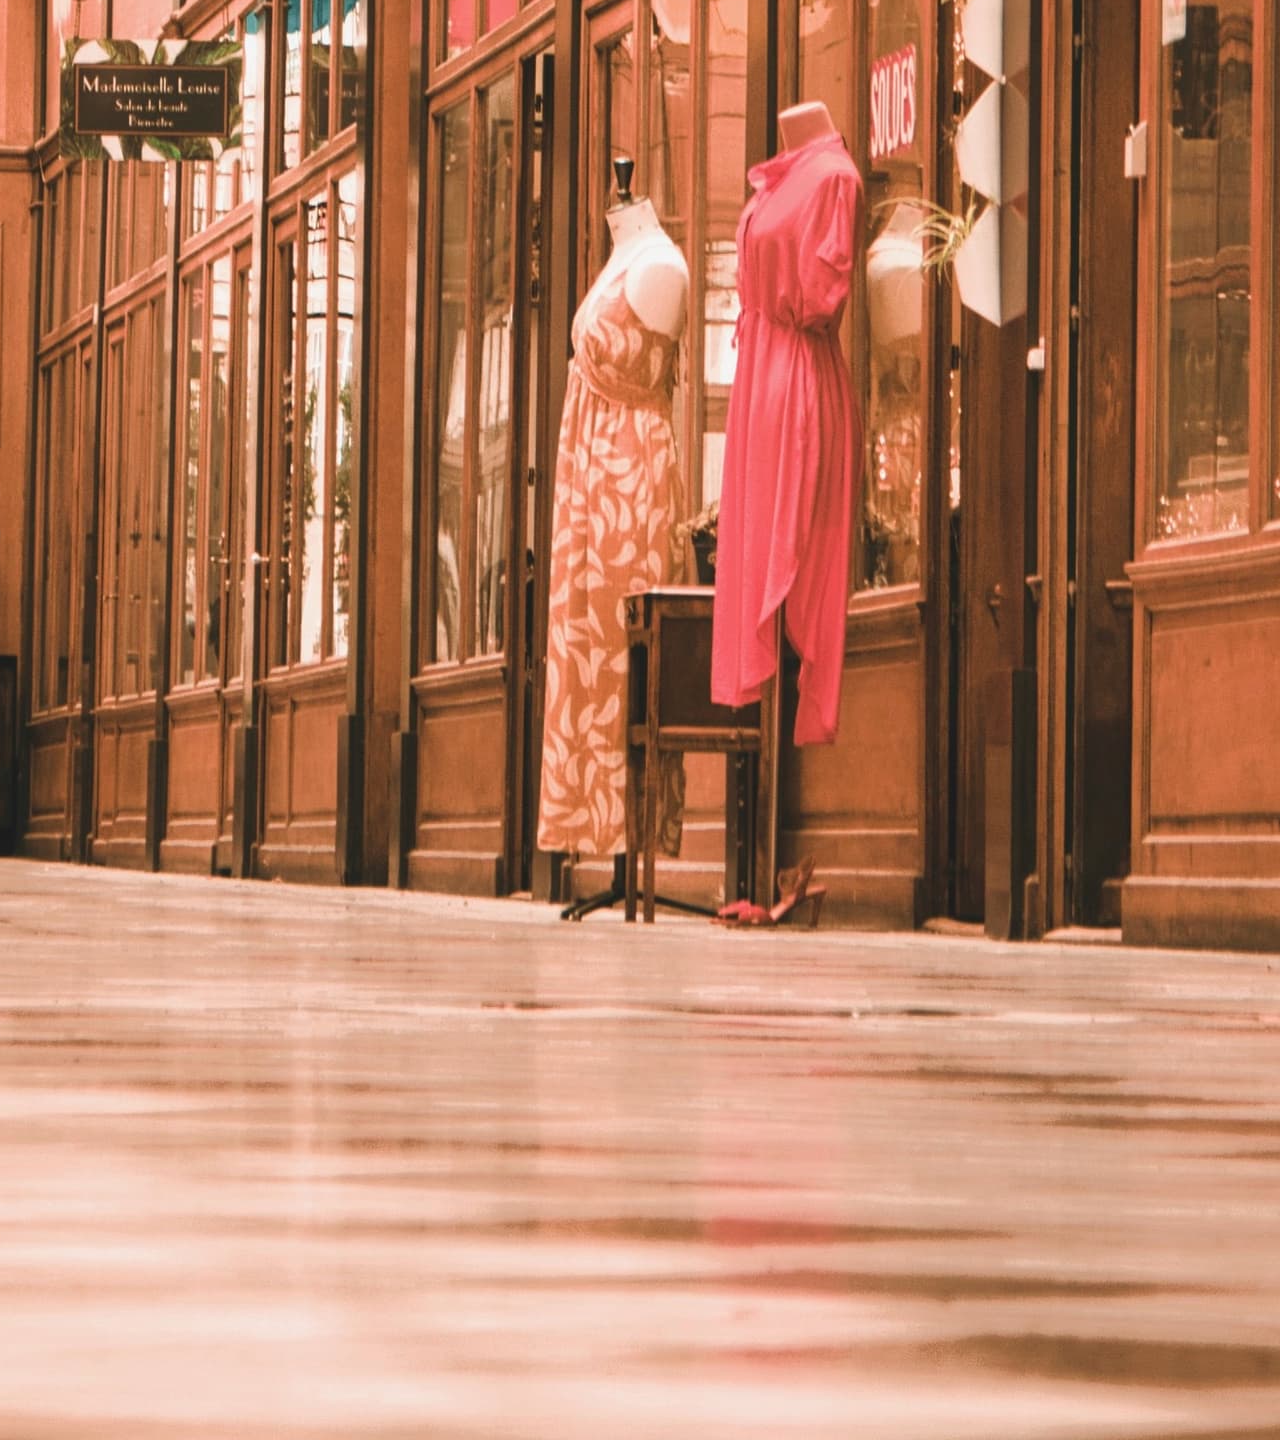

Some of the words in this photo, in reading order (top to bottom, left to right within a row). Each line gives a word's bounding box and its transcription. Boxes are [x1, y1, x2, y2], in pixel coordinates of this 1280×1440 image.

[83, 75, 174, 94] Mademoiselle
[177, 76, 221, 95] Louise
[114, 98, 143, 112] Salon
[870, 52, 917, 160] SOLDES
